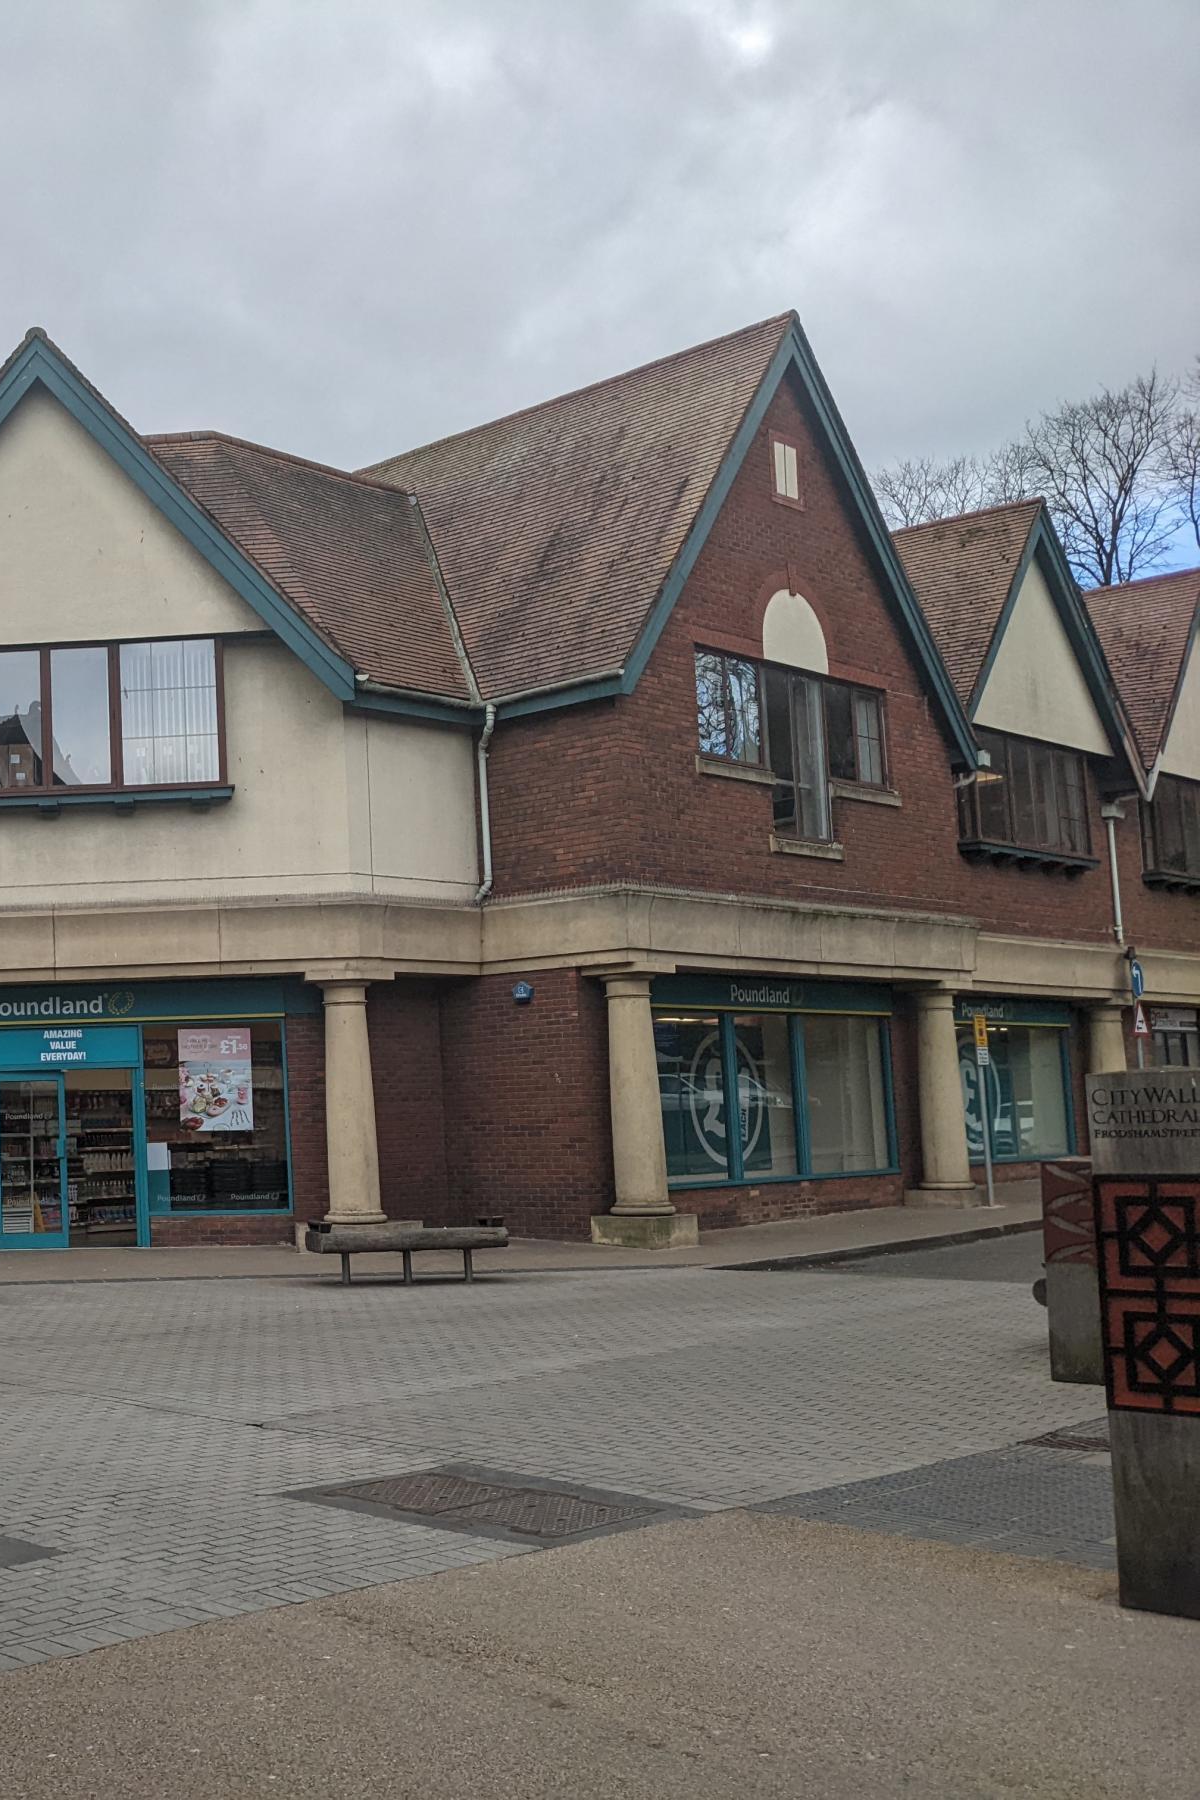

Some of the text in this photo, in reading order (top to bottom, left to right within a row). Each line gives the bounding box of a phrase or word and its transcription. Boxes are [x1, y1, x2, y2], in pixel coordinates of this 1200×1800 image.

[730, 984, 791, 1004] Poundland
[43, 1029, 83, 1039] AMAZING
[49, 1041, 77, 1050] VALUE
[40, 1051, 87, 1062] EVERYDAY!
[5, 1112, 43, 1121] Poundland
